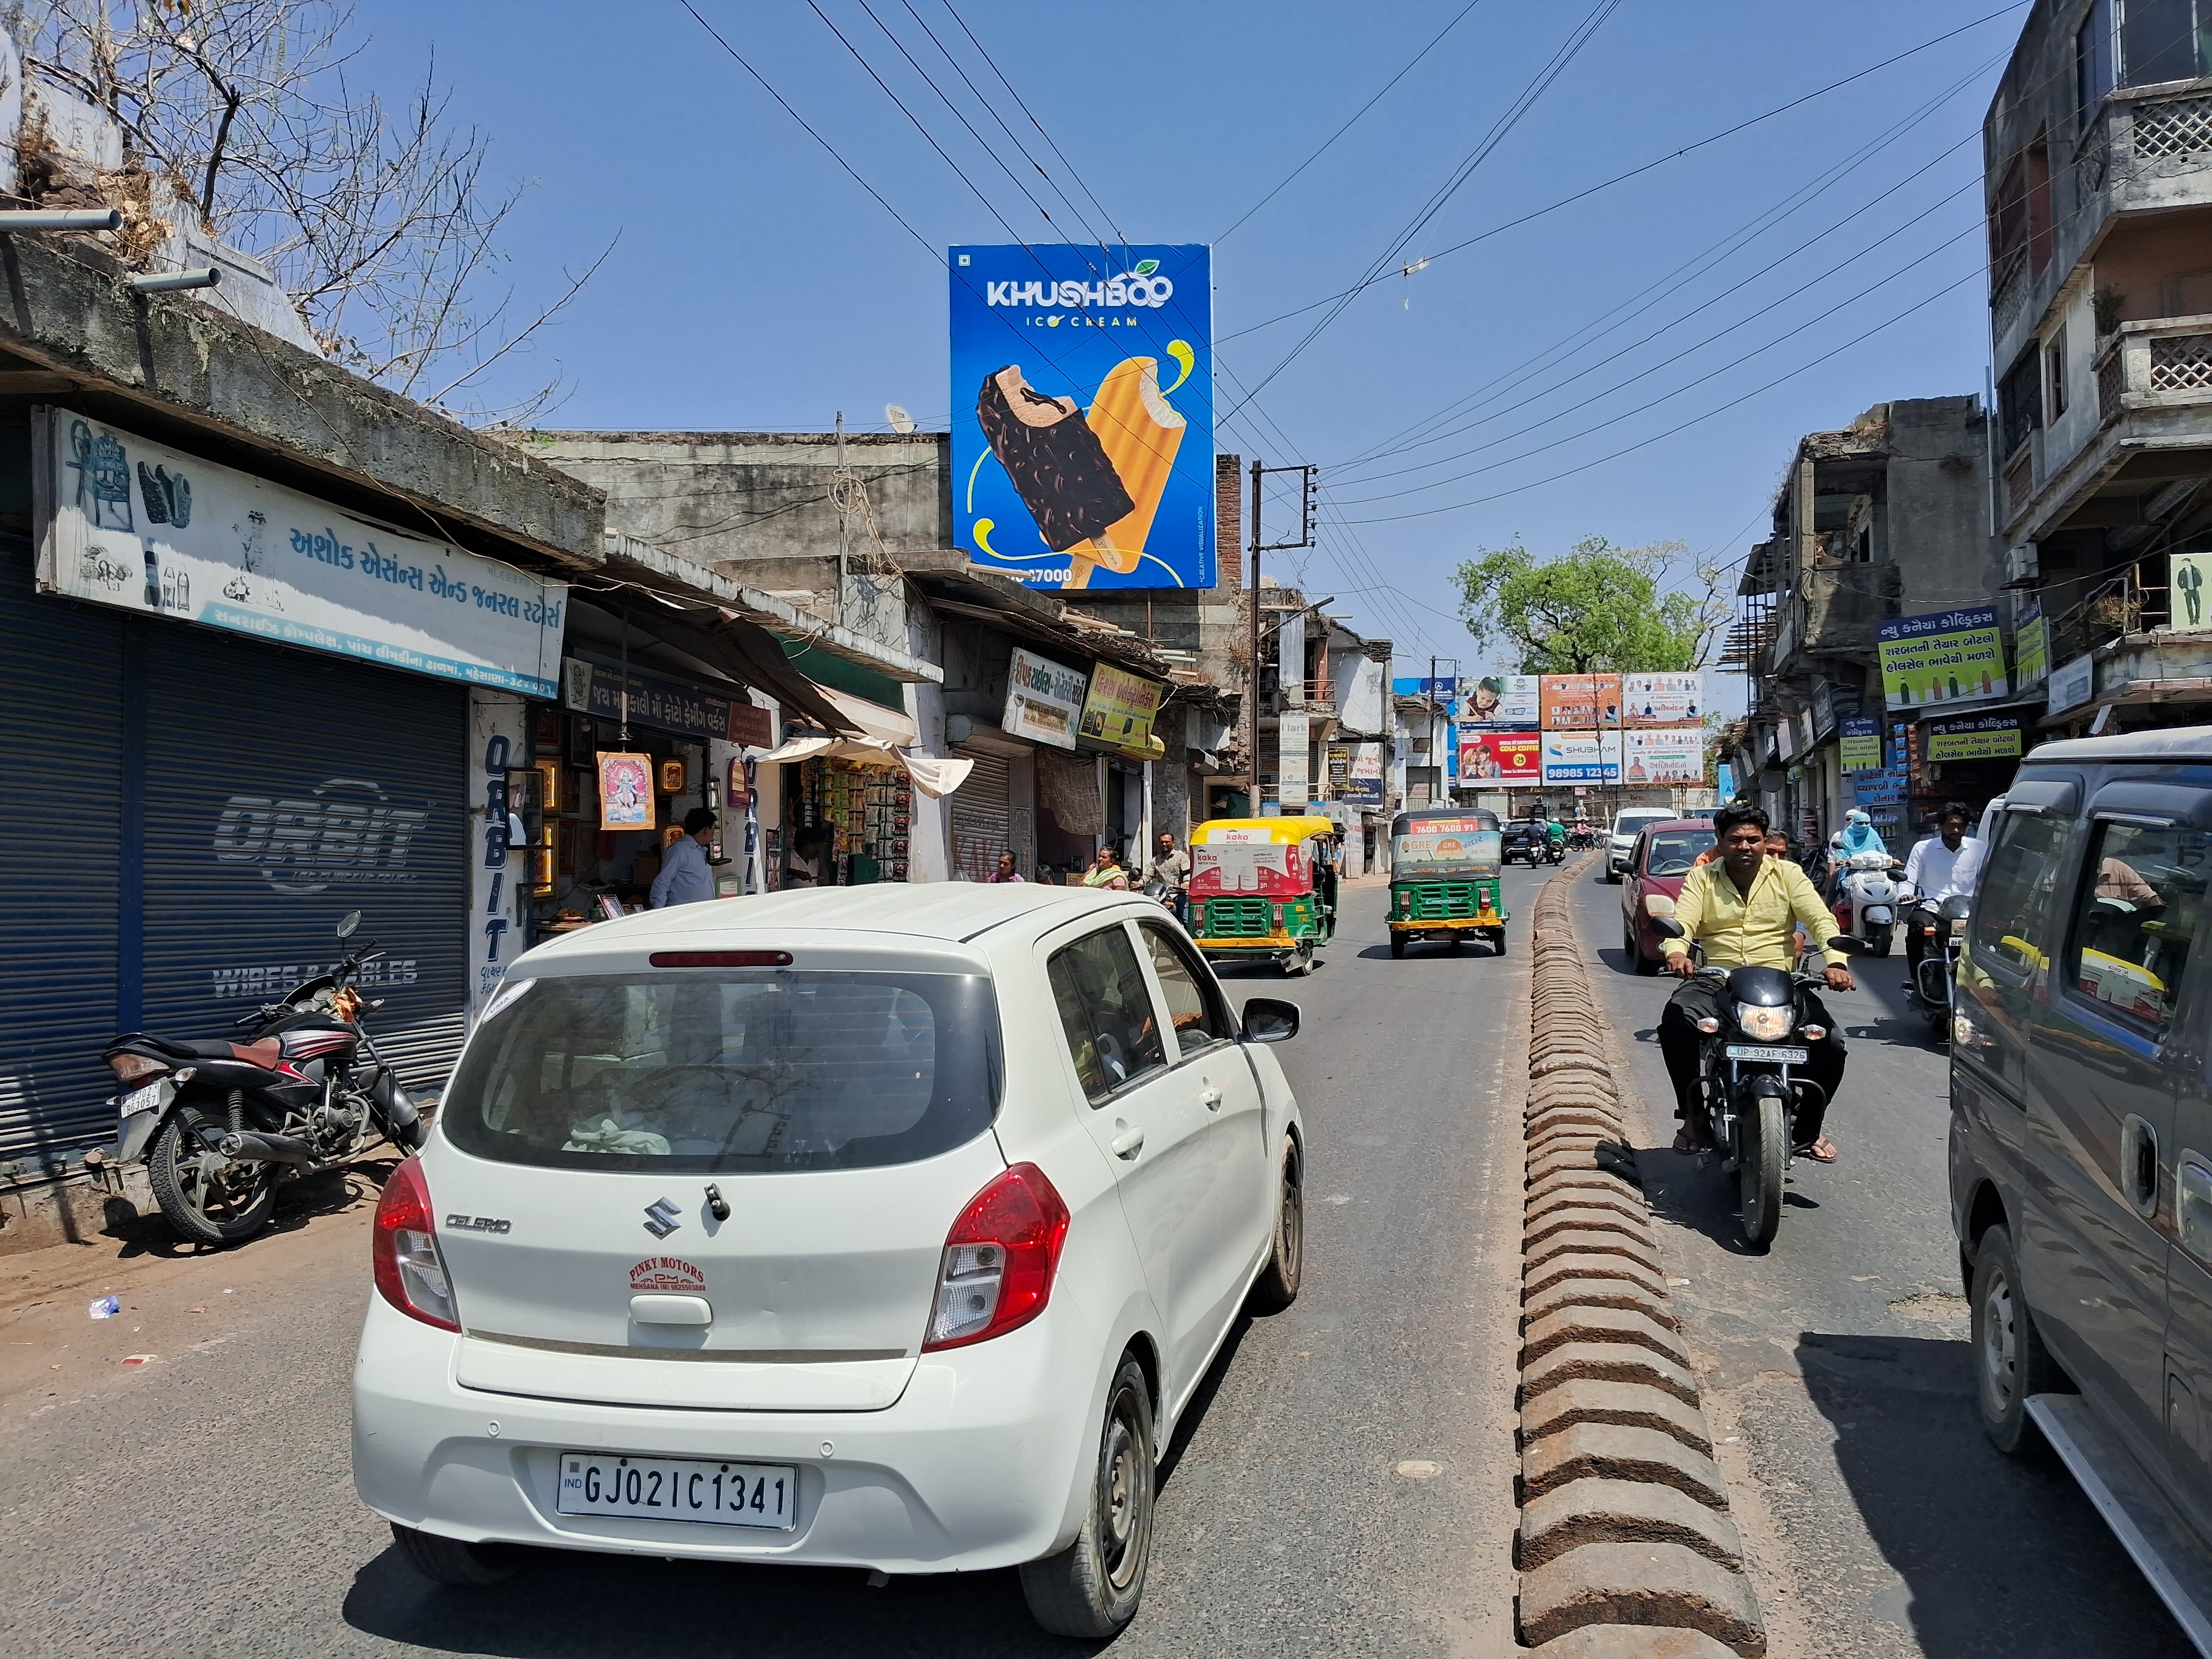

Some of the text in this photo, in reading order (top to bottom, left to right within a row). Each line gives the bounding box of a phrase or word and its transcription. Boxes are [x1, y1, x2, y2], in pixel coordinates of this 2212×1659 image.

[987, 272, 1173, 307] KHUSHBOO
[1071, 316, 1138, 327] CREAM
[290, 527, 353, 569] અશોક
[429, 565, 467, 603] એન્ડ
[472, 586, 519, 618] જનરલ
[1881, 626, 1899, 639] ન્યુ
[1902, 619, 1936, 633] કનૈયા
[346, 638, 371, 655] પાંચ
[1885, 631, 1995, 656] શરબતની તૈયાર બોટલો
[1886, 658, 1924, 673] હોલસેલ
[1928, 652, 1963, 667] ભાવેથી
[594, 685, 609, 707] જય
[1933, 724, 1946, 734] ન્યુ
[1949, 721, 1975, 731] કનૈયા
[1936, 737, 1968, 747] શરબતની
[1993, 734, 2015, 743] બોટલો
[1935, 749, 1963, 759] હોલસેલ
[1548, 767, 1617, 778] 98985 12345
[1197, 853, 1218, 861] kaka
[629, 1257, 704, 1283] PINKY MOTORS
[564, 1478, 582, 1489] IND
[585, 1467, 785, 1515] GJ02IC1341
